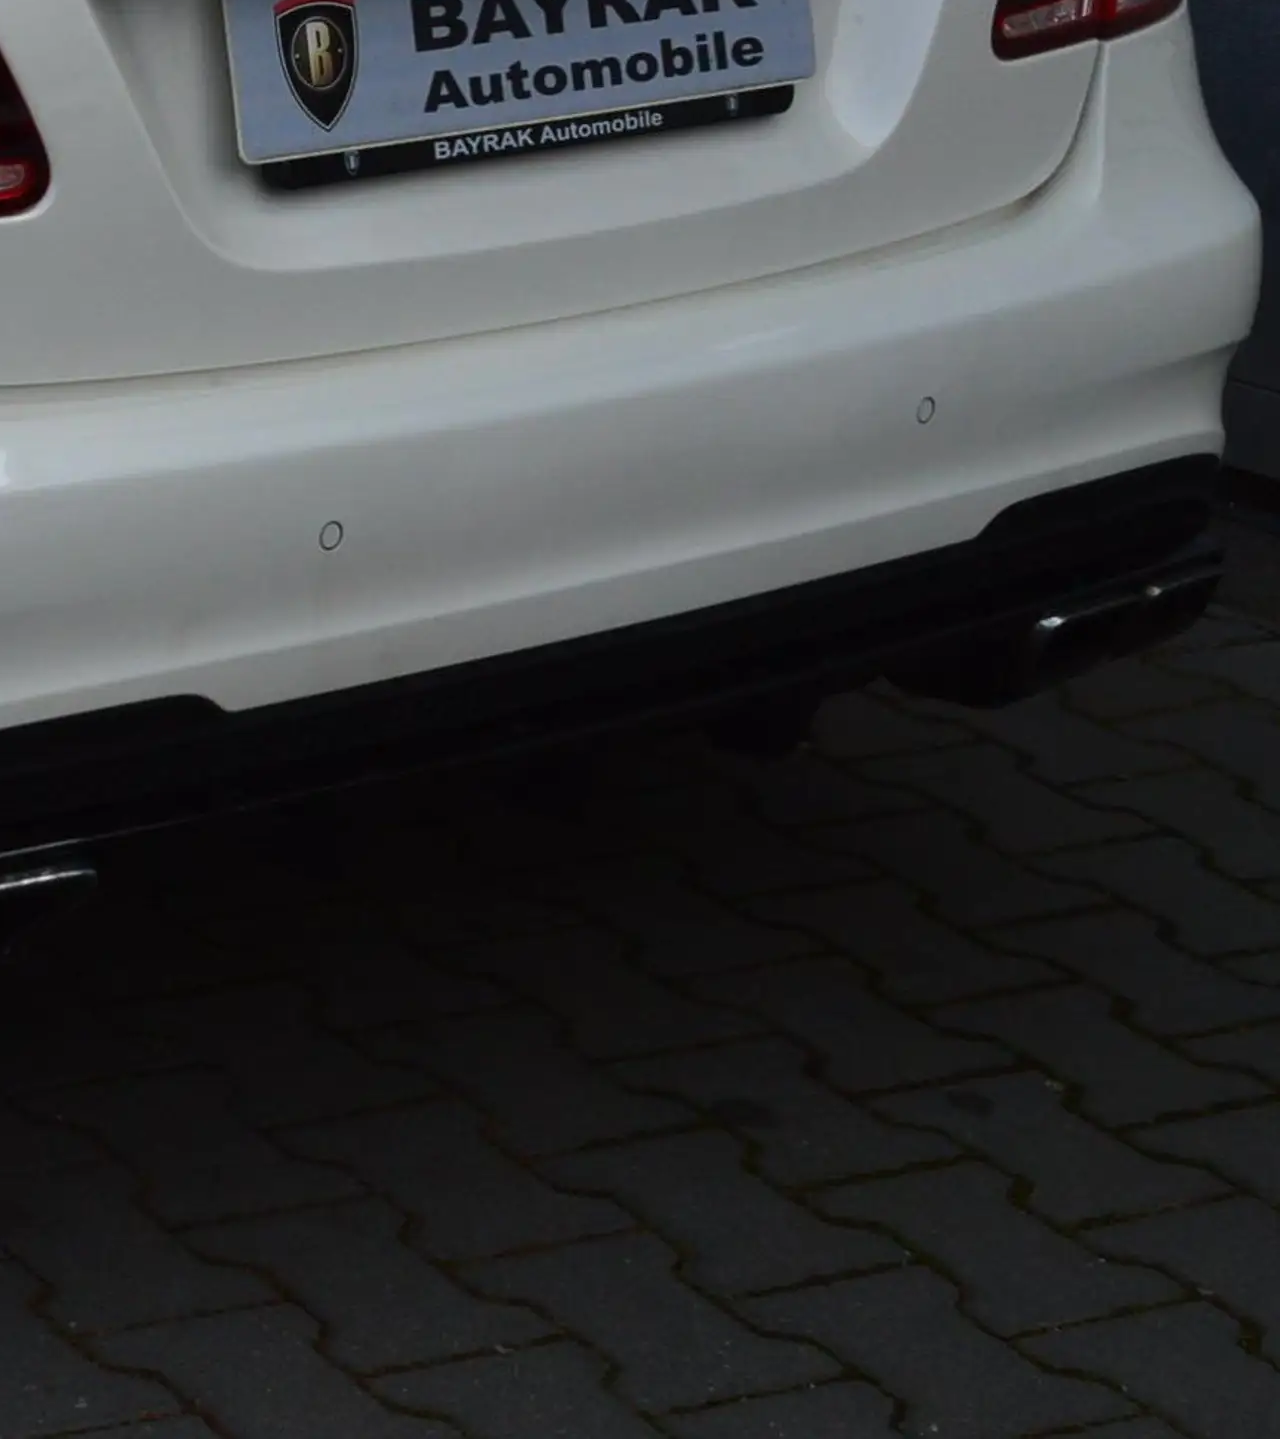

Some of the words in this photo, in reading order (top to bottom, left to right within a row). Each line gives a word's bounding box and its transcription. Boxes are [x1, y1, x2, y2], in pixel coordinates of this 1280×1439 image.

[305, 20, 335, 87] B
[423, 30, 765, 114] Automobile
[433, 128, 535, 160] BAYRAK
[539, 109, 665, 145] Automobile
